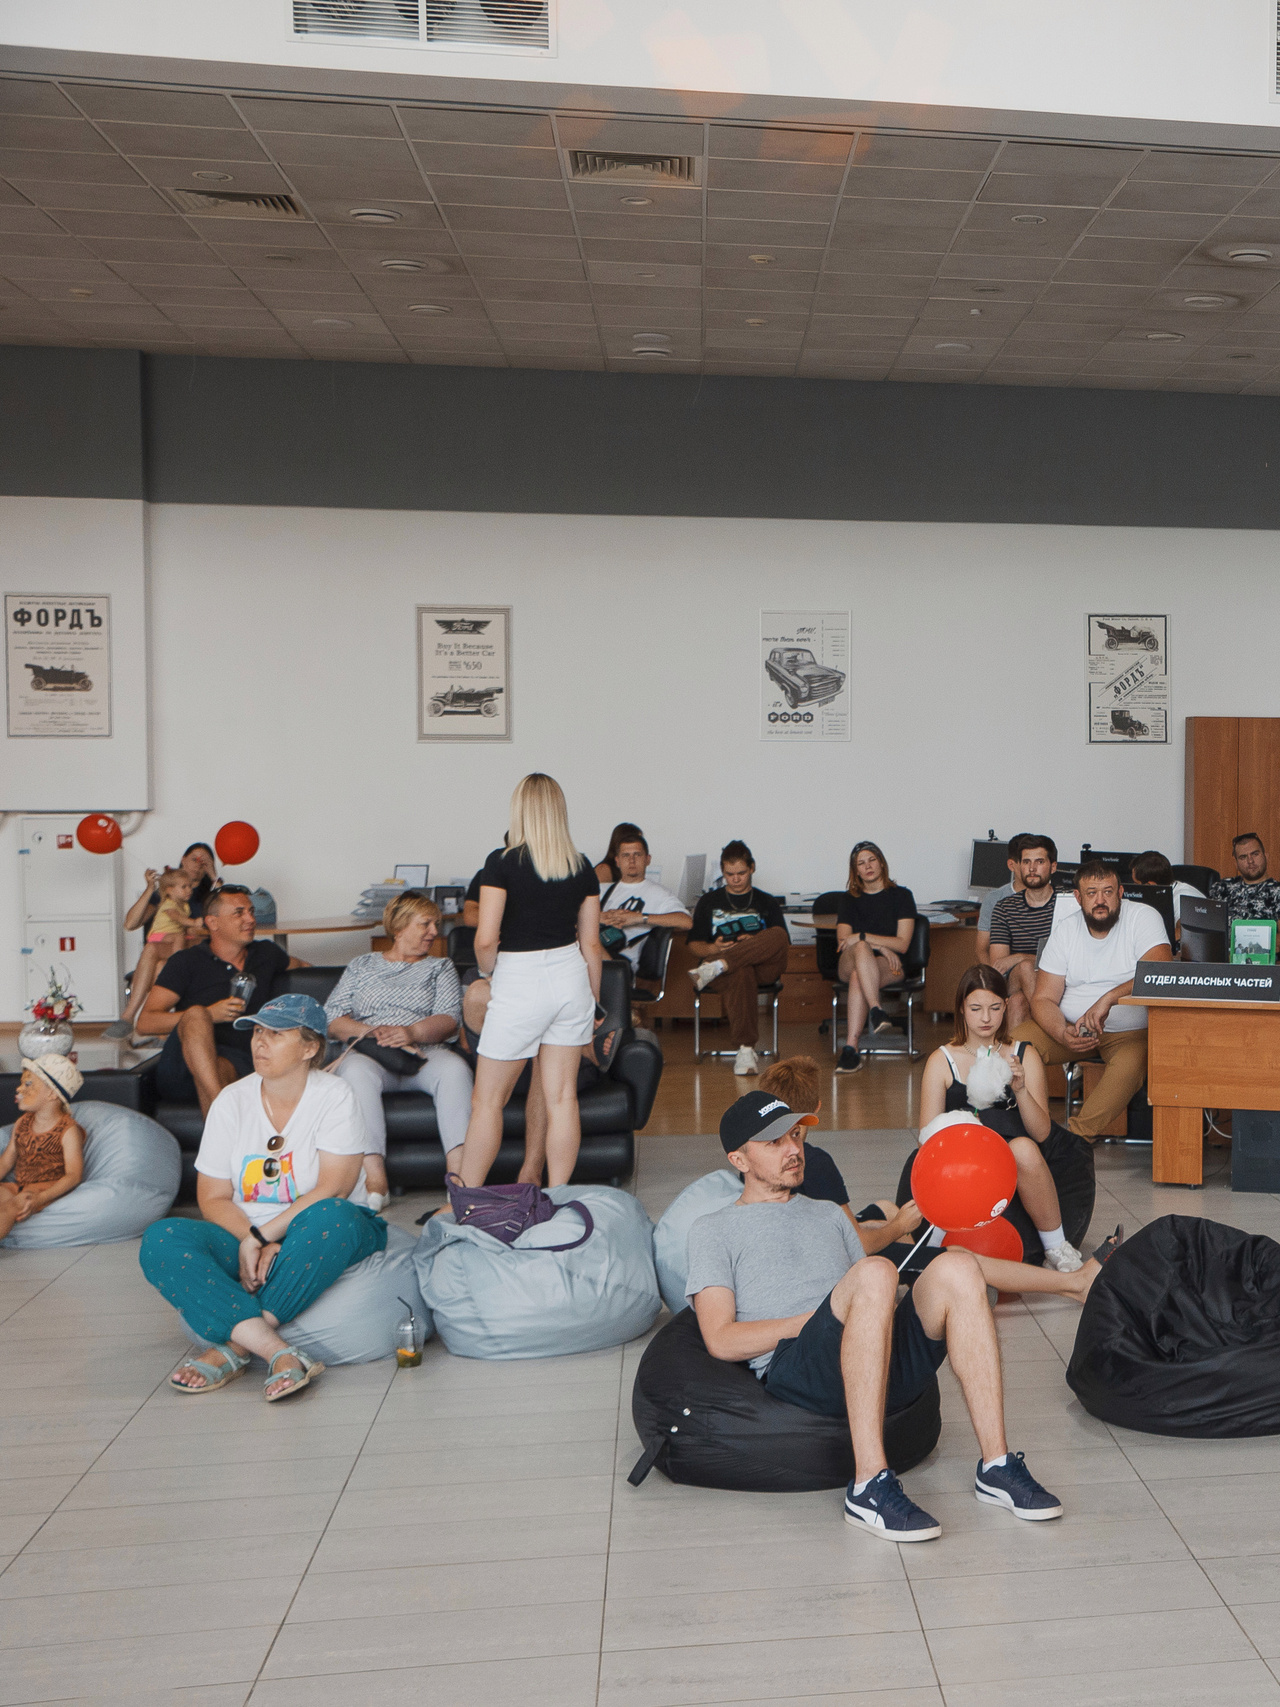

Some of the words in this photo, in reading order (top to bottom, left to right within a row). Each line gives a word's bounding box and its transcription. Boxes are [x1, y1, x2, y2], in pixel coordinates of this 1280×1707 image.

[13, 608, 103, 630] ФОРДЪ
[437, 642, 452, 650] Buy
[768, 712, 814, 723] FORD
[1144, 974, 1177, 985] ОТДЕЛ
[1178, 975, 1232, 987] ЗАПАСНЫХ
[1233, 977, 1273, 988] ЧАСТЕЙ
